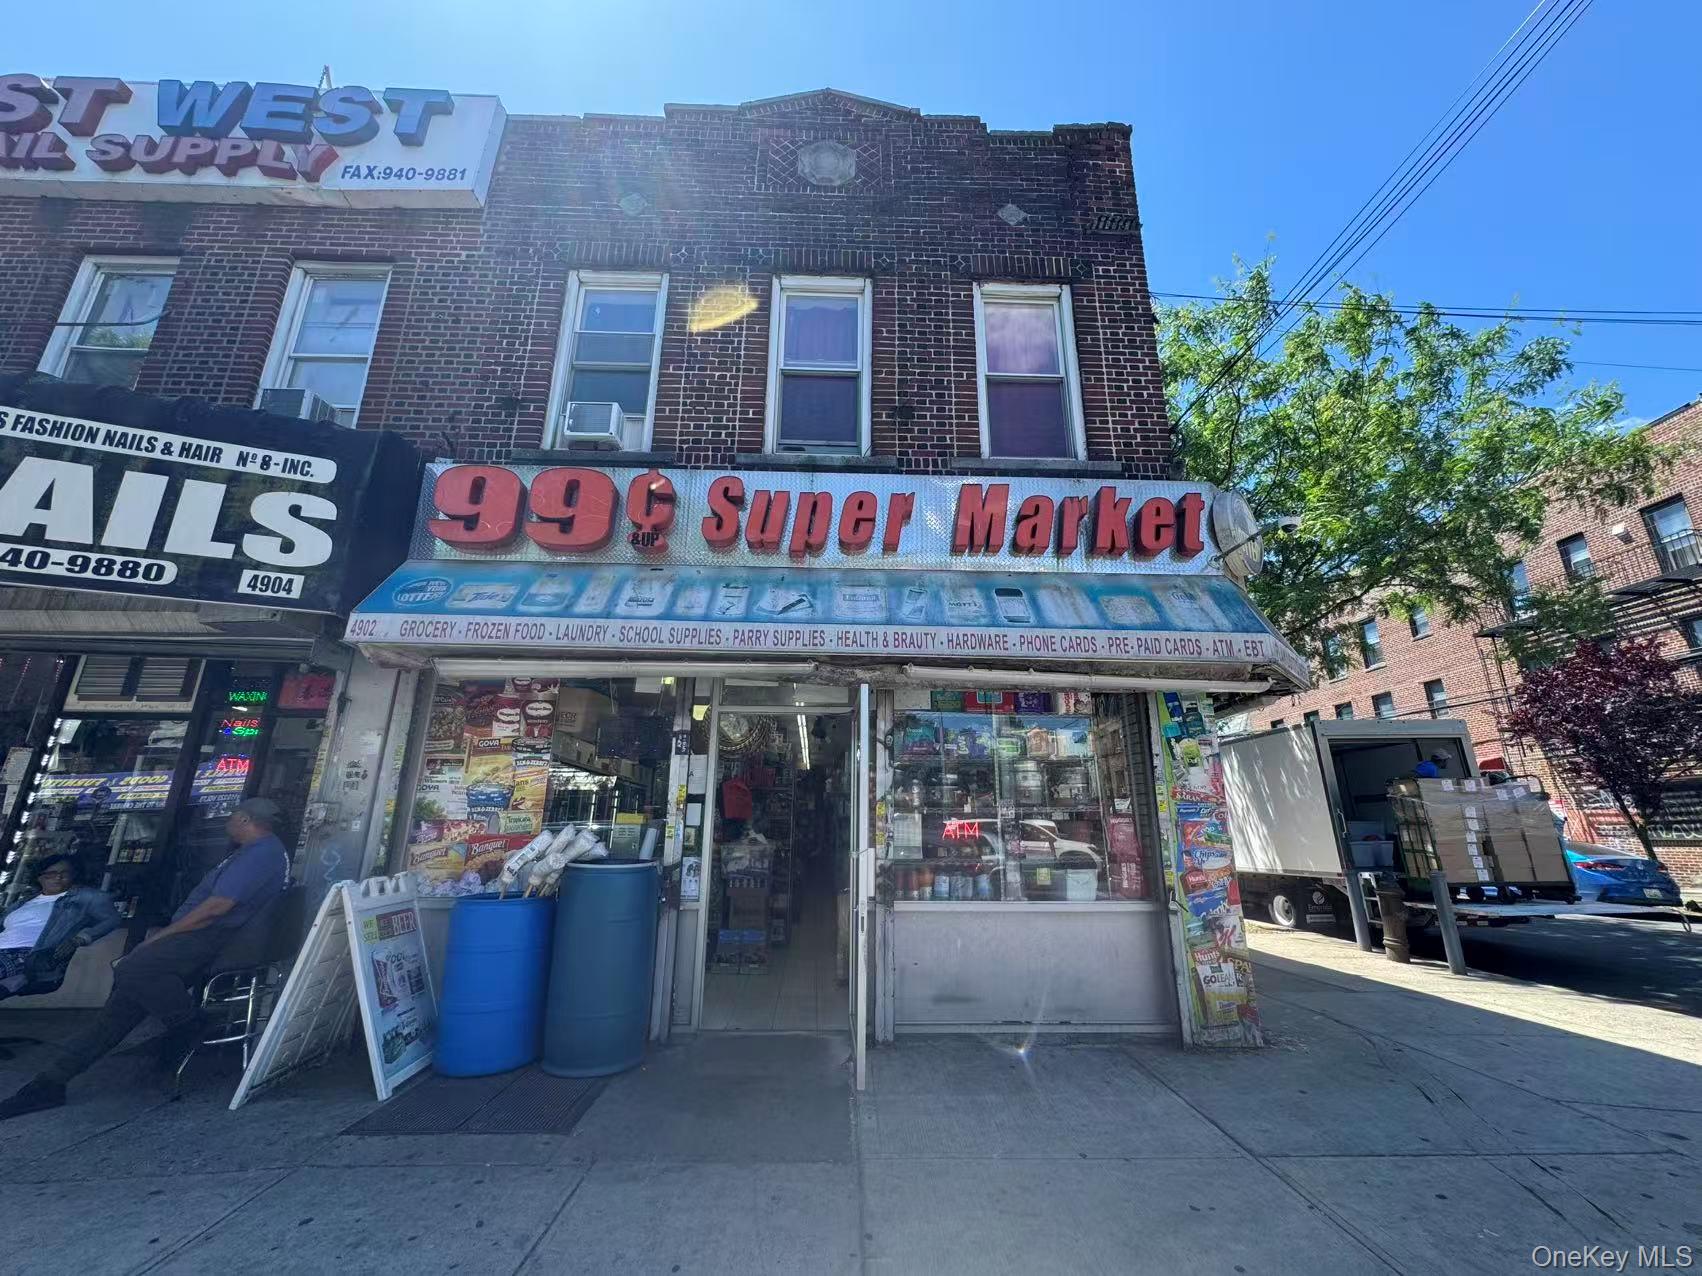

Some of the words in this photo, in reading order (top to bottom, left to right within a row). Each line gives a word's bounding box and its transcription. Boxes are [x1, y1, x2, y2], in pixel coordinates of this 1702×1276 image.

[157, 79, 454, 147] WEST
[0, 131, 76, 171] IL
[86, 133, 339, 182] SUPPLY
[341, 165, 467, 181] FAX:940-9881
[11, 414, 101, 444] FASHION
[102, 429, 159, 455] NAILS
[160, 441, 174, 456] &
[178, 442, 223, 464] HAIR
[0, 456, 337, 567] AILS
[702, 475, 916, 563] Super
[952, 483, 1205, 560] Market
[247, 574, 294, 595] 4904
[350, 619, 377, 637] 4902
[400, 620, 456, 639] GROCERY
[465, 621, 511, 640] FROZEN
[514, 622, 545, 640] FOOD
[556, 624, 609, 642] LAUNDRY
[619, 625, 664, 644] SCHOOL
[668, 627, 722, 646] SUPPLIES
[733, 630, 770, 646] PARRY
[773, 630, 826, 648] SUPPLIES
[836, 630, 879, 648] HEALTH
[882, 632, 889, 648] &
[893, 631, 936, 649] BRAUTY
[947, 633, 1009, 651] HARDWARE
[1020, 634, 1056, 652] PHONE
[1060, 636, 1097, 653] CARDS
[1137, 638, 1162, 655] PAID
[1164, 638, 1202, 656] CARDS
[1212, 639, 1234, 657] ATM
[1244, 640, 1265, 657] EBT
[229, 692, 267, 702] WAXIN
[479, 740, 500, 748] GOYA
[216, 758, 249, 772] ATM
[942, 820, 981, 841] ATM
[470, 839, 506, 856] Banquet
[392, 911, 417, 935] BEER
